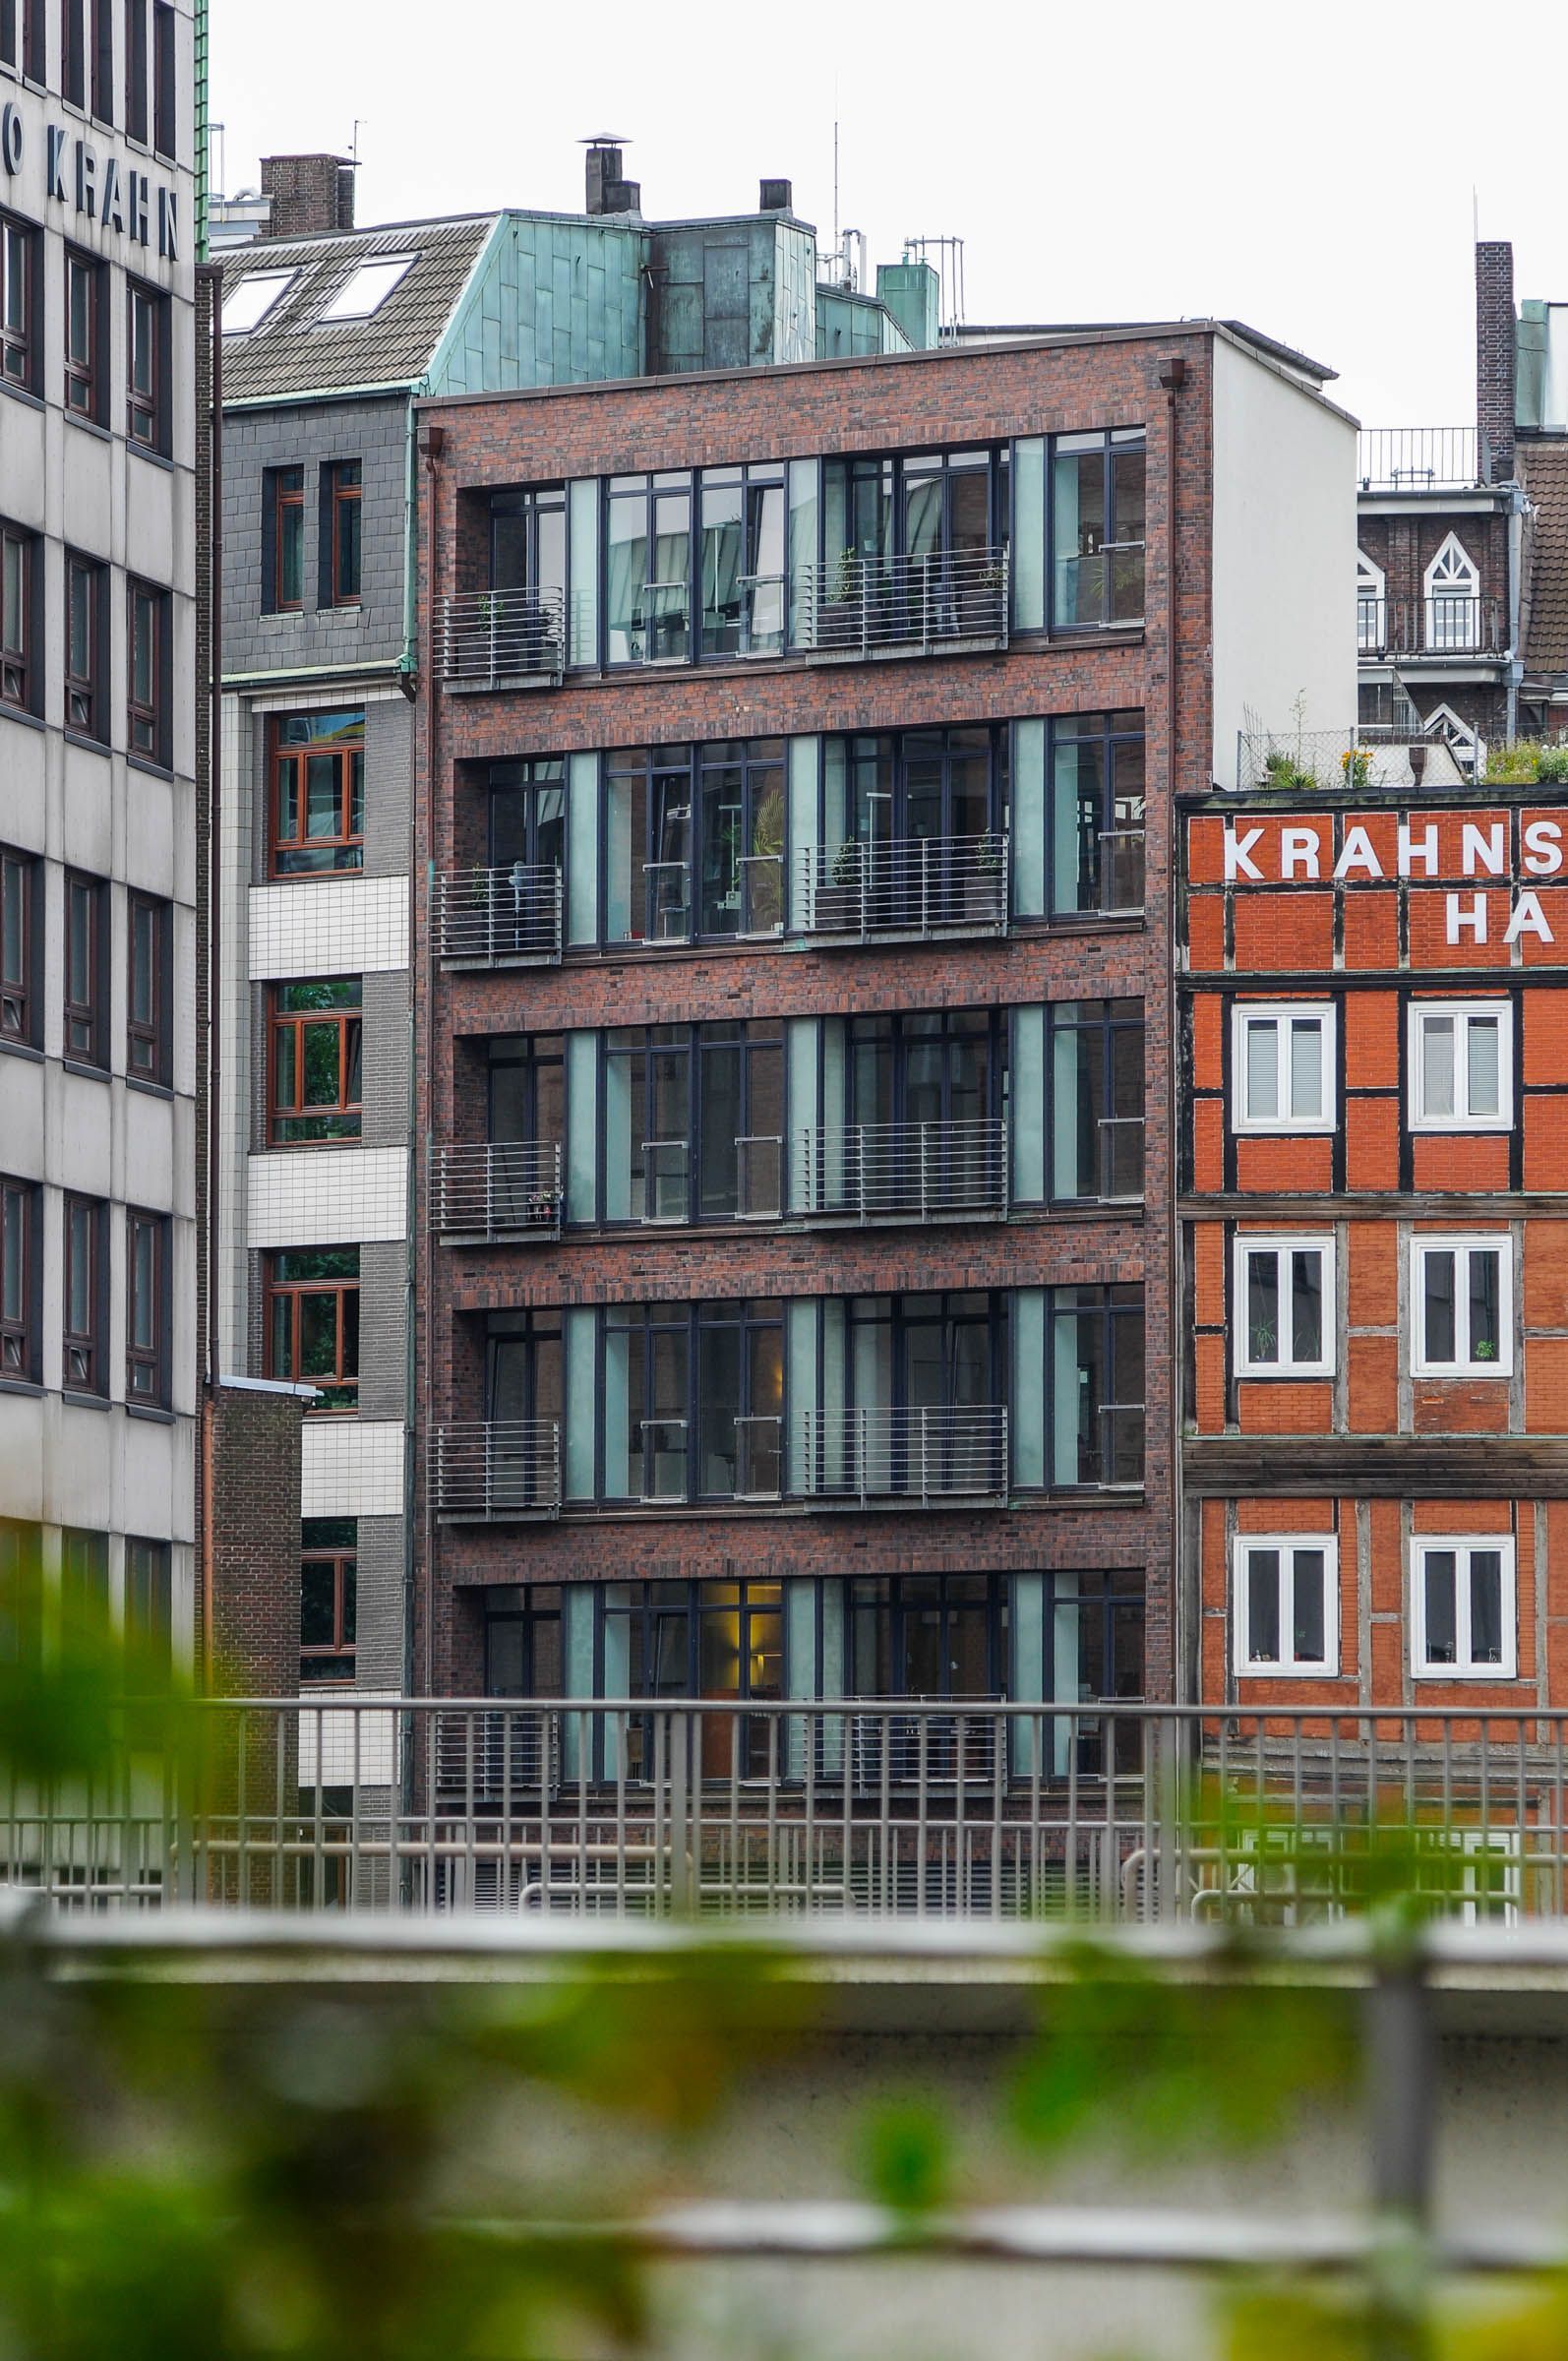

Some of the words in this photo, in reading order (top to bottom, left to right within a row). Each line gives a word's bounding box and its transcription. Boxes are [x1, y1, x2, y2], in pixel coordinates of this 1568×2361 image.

[47, 124, 178, 262] KRAHN
[1224, 820, 1563, 880] KRAHNS
[1446, 891, 1555, 945] HA
